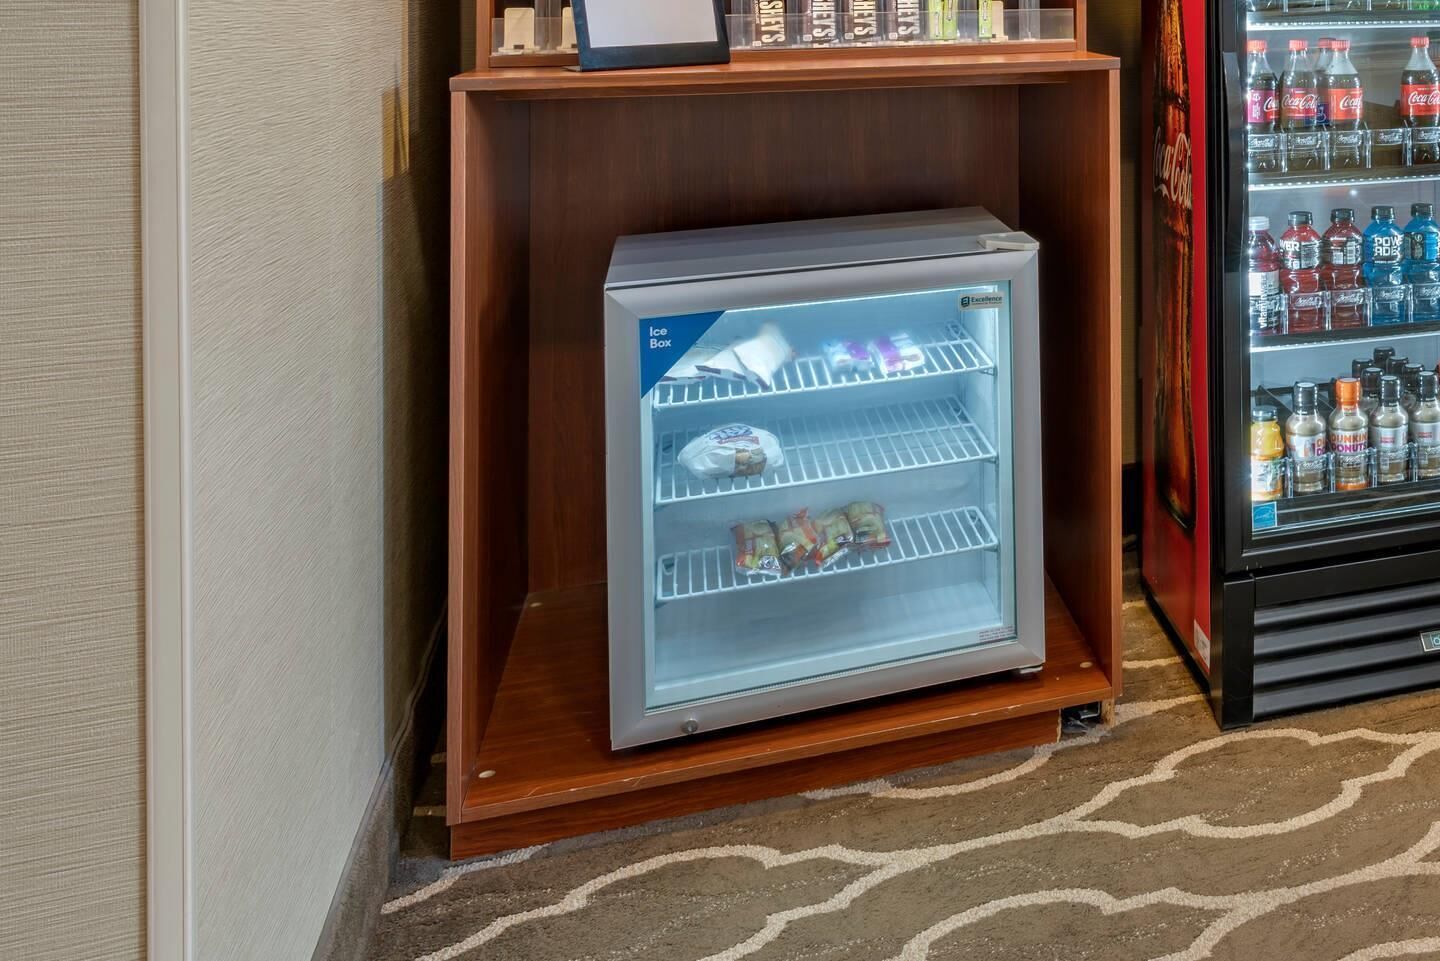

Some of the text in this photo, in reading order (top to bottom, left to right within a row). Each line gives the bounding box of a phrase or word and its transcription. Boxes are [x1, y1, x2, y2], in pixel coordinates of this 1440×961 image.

[649, 326, 667, 337] Ice
[650, 338, 671, 349] Box
[1331, 442, 1366, 452] DONUTS
